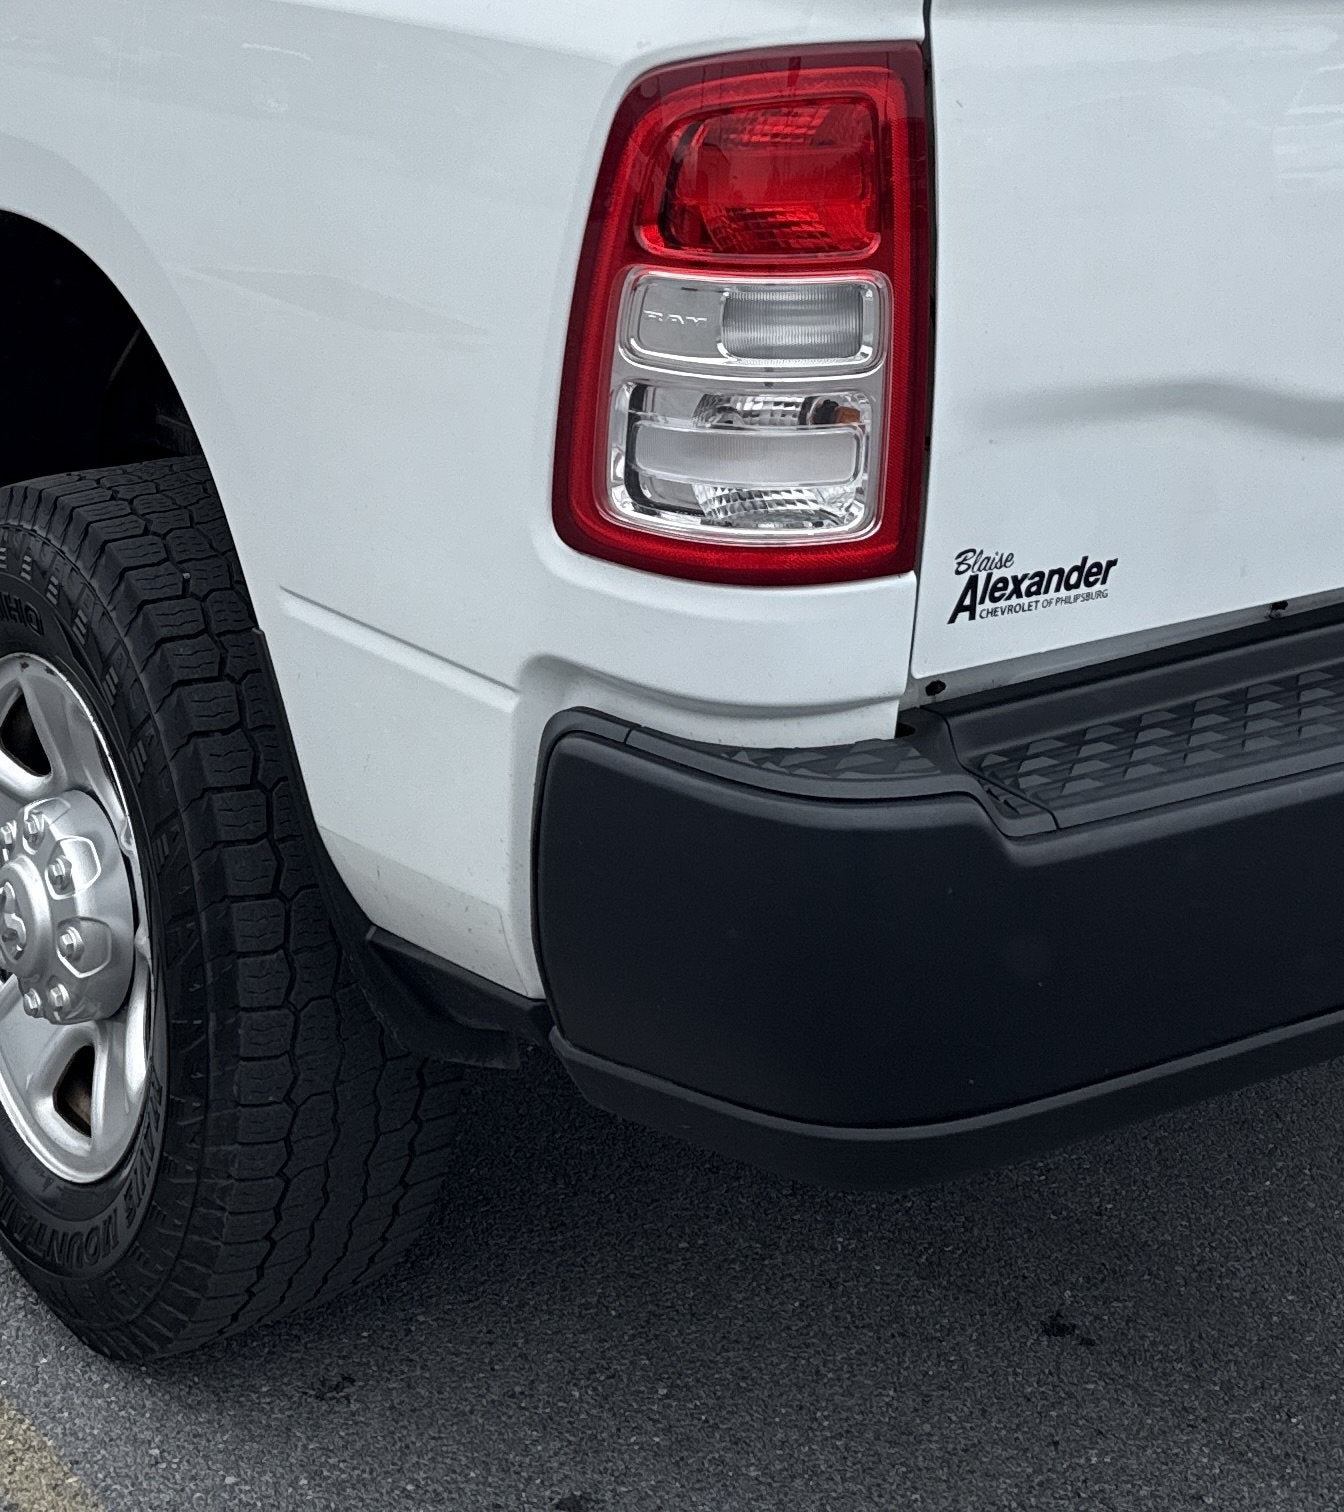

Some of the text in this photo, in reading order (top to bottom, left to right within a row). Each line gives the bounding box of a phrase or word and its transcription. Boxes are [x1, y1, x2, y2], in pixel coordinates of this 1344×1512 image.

[954, 548, 1015, 576] Blaise
[946, 555, 1119, 625] Alexander
[978, 589, 1109, 620] CHEVROLET OF PHILIPSBURG
